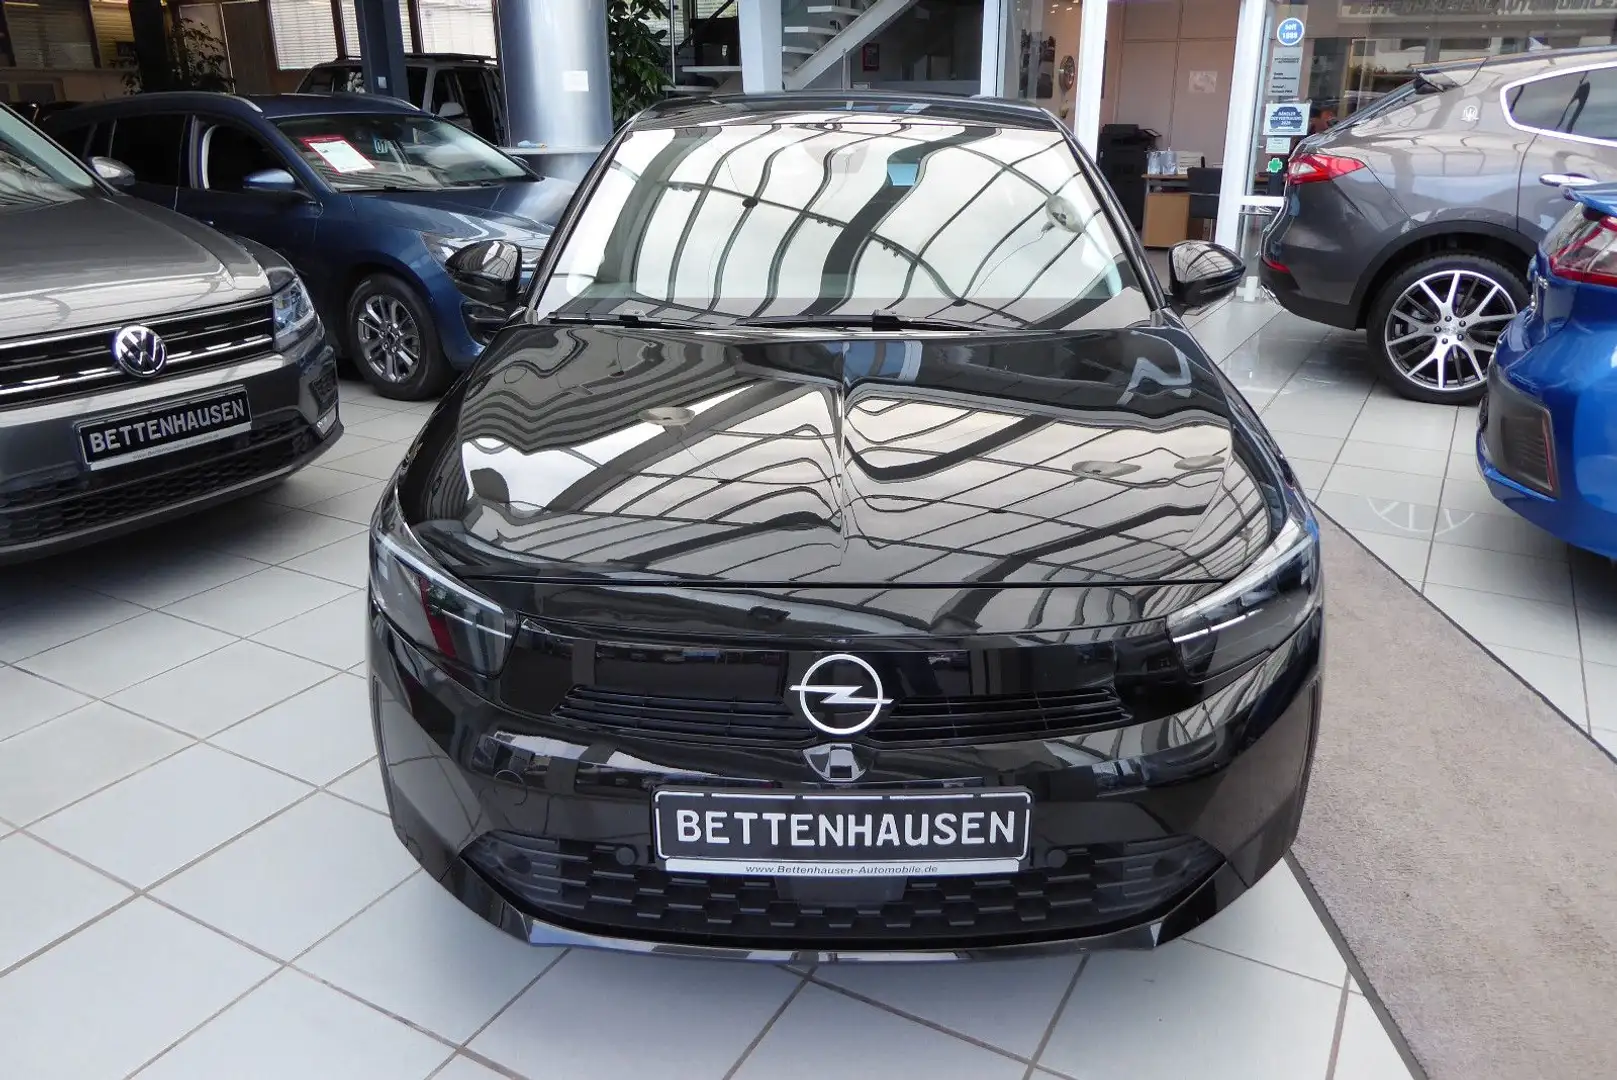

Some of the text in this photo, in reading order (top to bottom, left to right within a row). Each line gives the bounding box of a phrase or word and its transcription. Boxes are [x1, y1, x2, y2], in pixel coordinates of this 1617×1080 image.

[89, 398, 246, 454] BETTENHAUSEN
[675, 809, 1016, 847] BETTENHAUSEN
[745, 863, 939, 876] www.Bettenhausen-Automobile.de
